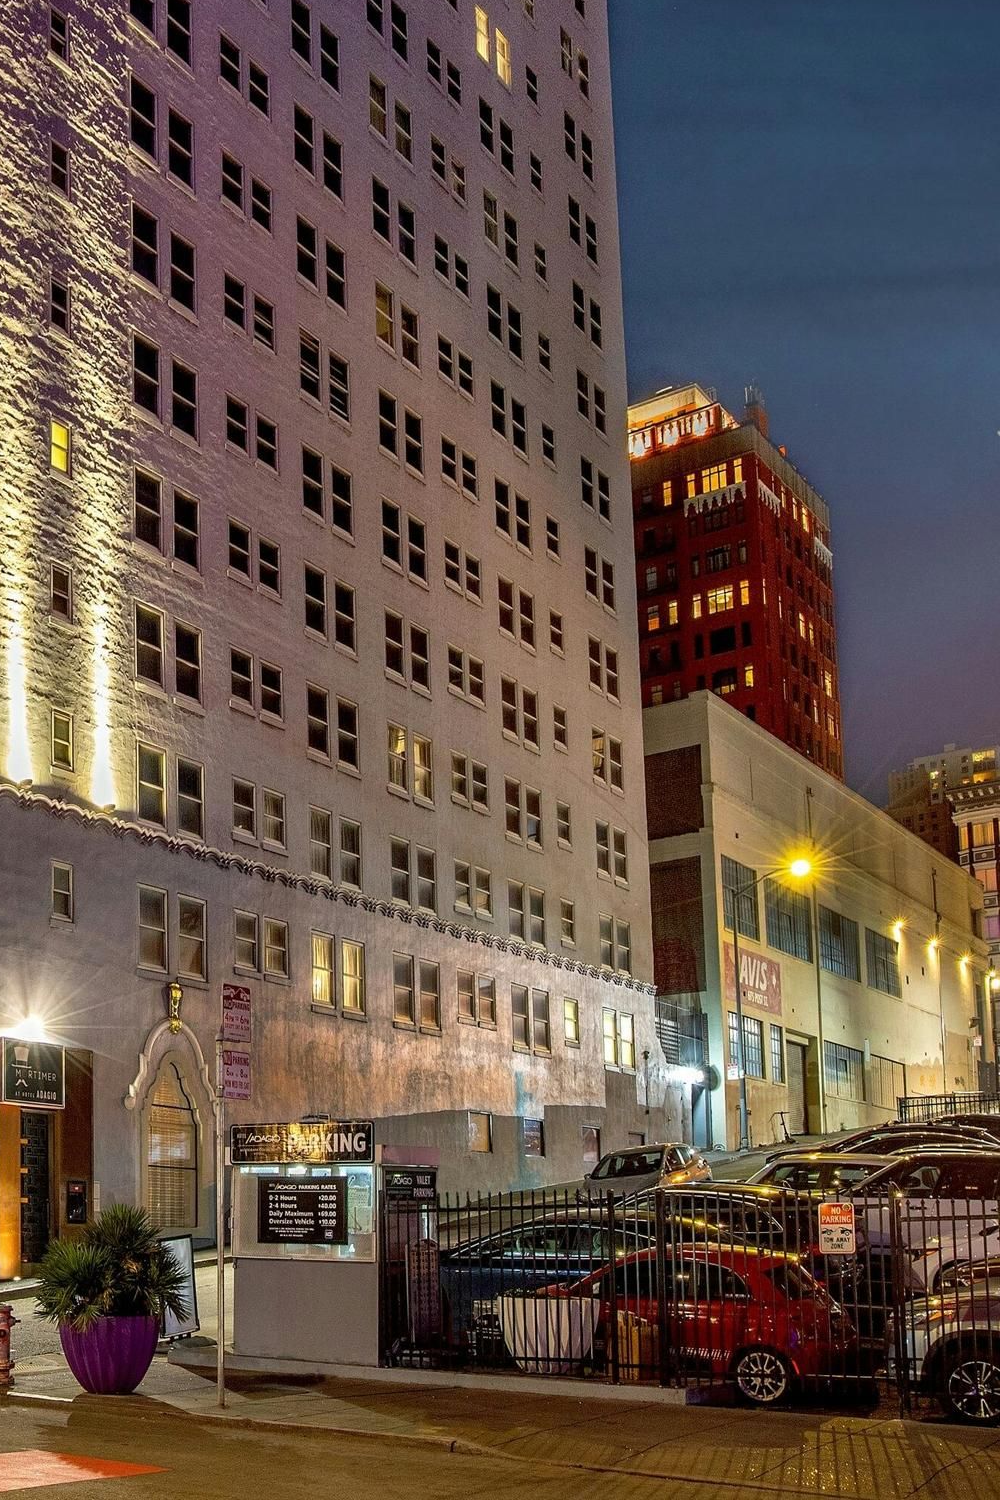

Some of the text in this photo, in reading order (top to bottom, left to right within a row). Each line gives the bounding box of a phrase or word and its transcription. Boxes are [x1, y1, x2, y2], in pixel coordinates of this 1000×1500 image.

[740, 954, 767, 991] AVIS
[232, 1002, 250, 1011] PARKING
[233, 1056, 249, 1066] PARKING
[36, 1090, 56, 1100] ADAGIO
[249, 1133, 280, 1143] ADAGIO
[287, 1132, 366, 1153] PARKING
[393, 1176, 412, 1185] ADAGIO
[416, 1176, 430, 1184] VALET
[413, 1188, 434, 1197] PARKING
[831, 1206, 841, 1214] NO
